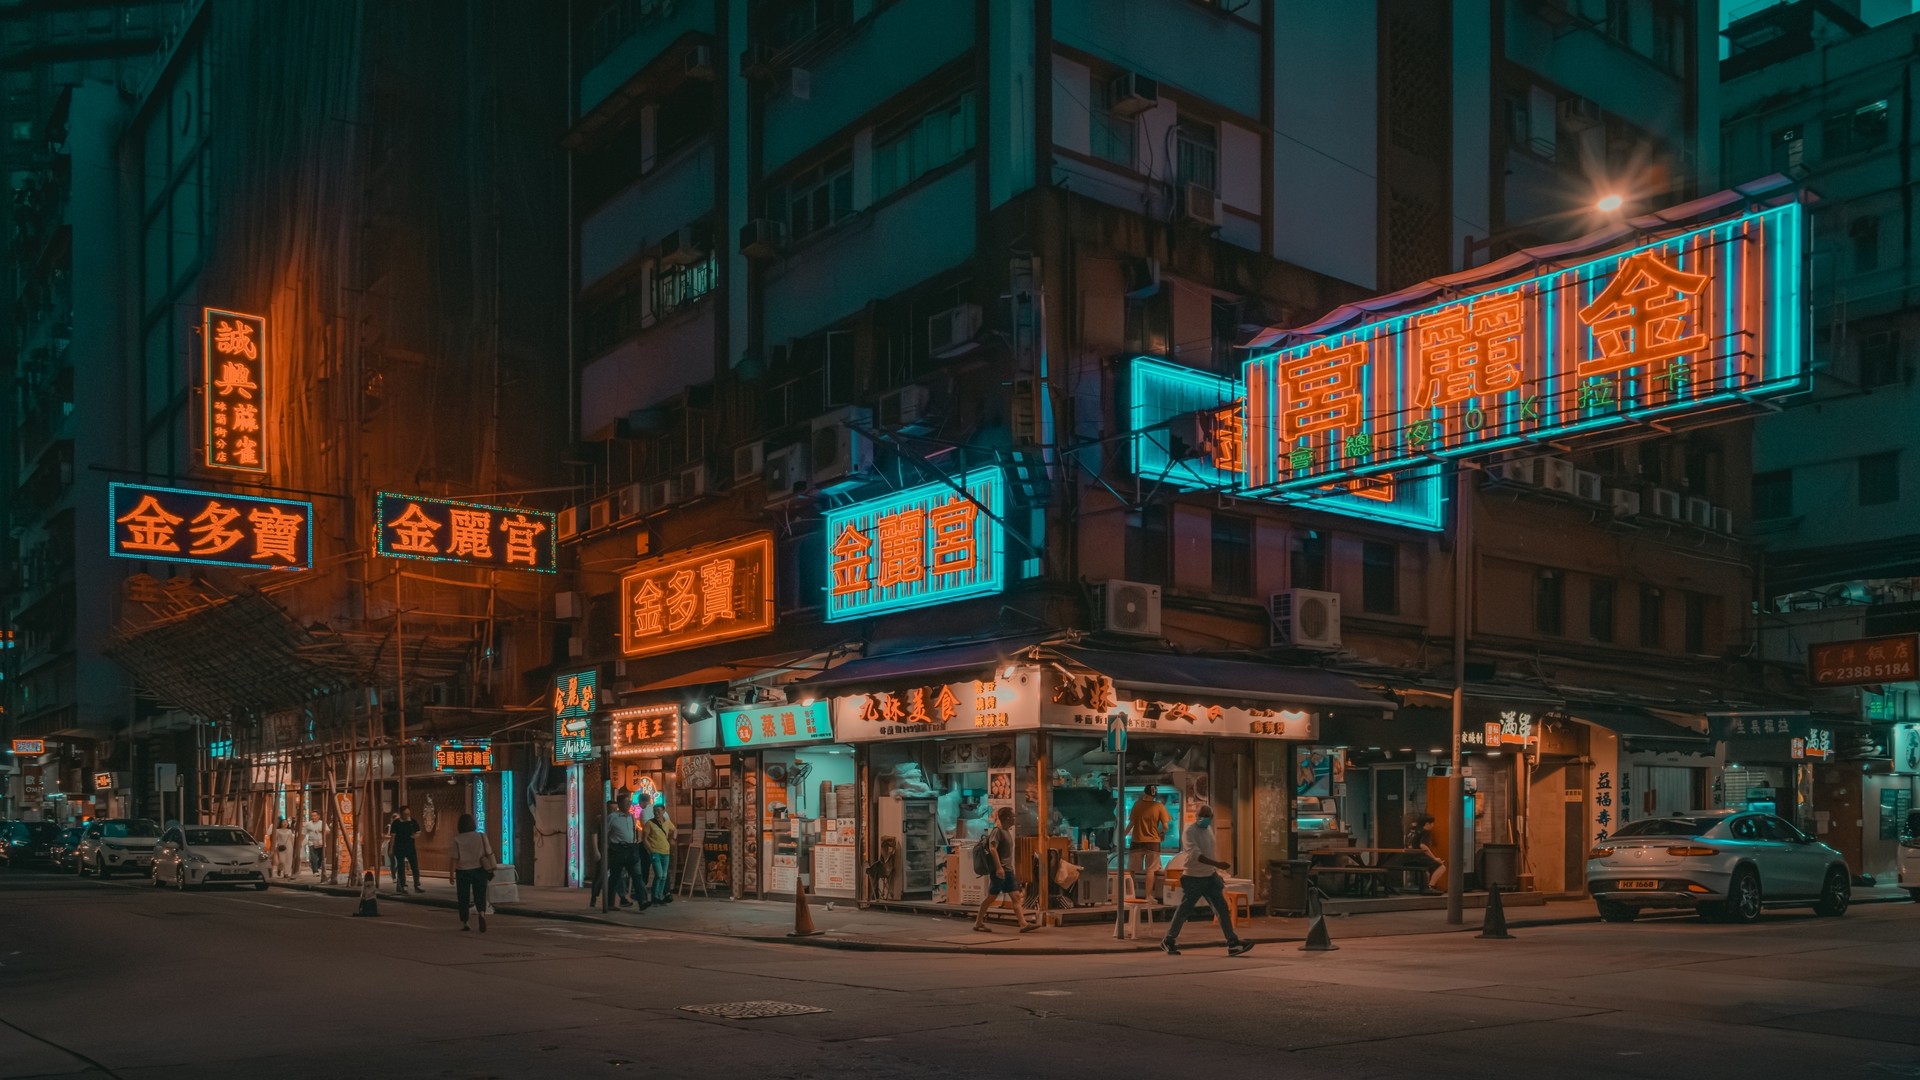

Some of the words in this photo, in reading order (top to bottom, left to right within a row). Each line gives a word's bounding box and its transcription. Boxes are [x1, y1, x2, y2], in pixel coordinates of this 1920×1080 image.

[1277, 249, 1712, 442] 金麗宮
[116, 495, 304, 563] 金多寶
[387, 502, 545, 566] 金麗宮
[829, 496, 979, 596] 金麗宮
[634, 557, 736, 638] 金多寶
[554, 676, 593, 715] 金麗宮
[1837, 666, 1871, 679] 2388
[1875, 662, 1910, 676] 5184
